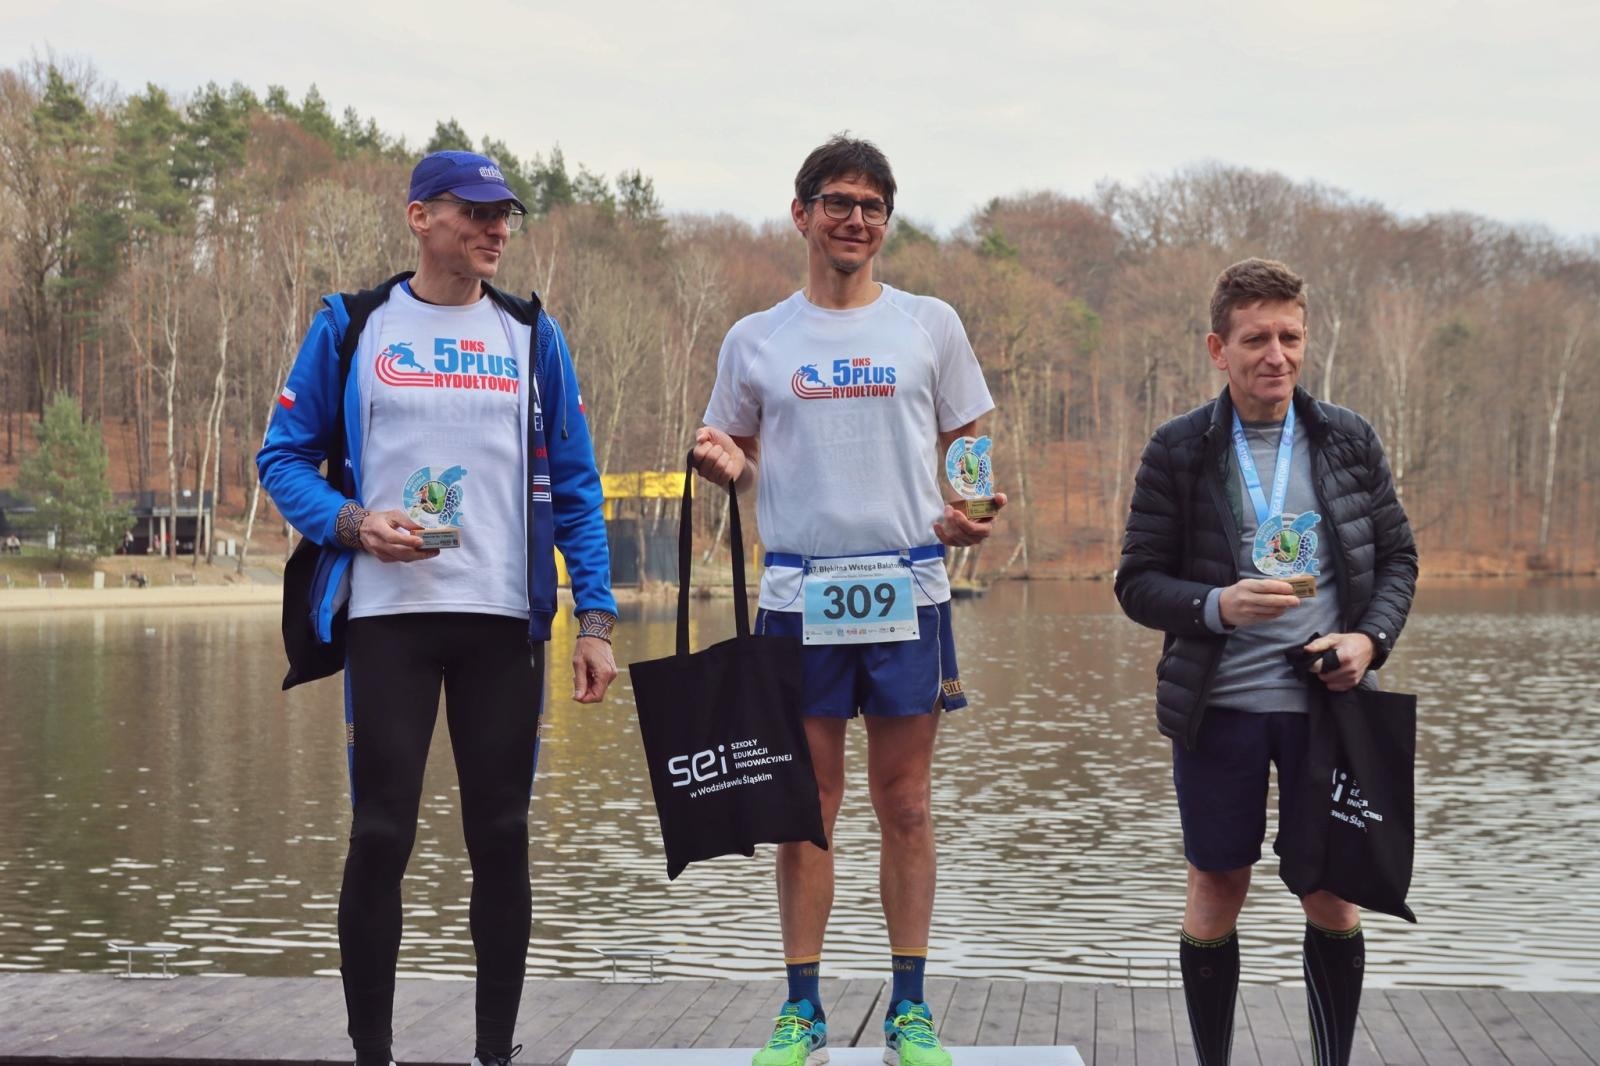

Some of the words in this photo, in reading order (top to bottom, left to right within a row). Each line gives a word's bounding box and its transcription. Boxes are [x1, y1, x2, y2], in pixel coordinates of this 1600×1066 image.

[460, 339, 485, 352] UKS
[434, 337, 459, 373] 5
[460, 353, 519, 379] PLUS
[852, 357, 871, 367] UKS
[833, 359, 851, 386] 5
[852, 366, 896, 385] PLUS
[433, 373, 520, 394] RYDUŁTOWY
[832, 385, 896, 399] RYDUŁTOWY
[848, 562, 876, 572] Wstęga
[823, 582, 896, 620] 309
[731, 738, 758, 750] SZKOŁY
[733, 747, 768, 760] EDUKACJI
[735, 753, 793, 769] INNOWACYJNEJ
[668, 745, 728, 788] sei
[690, 790, 697, 799] w
[698, 777, 743, 796] Wodzisławiu
[742, 771, 773, 785] Śląskim
